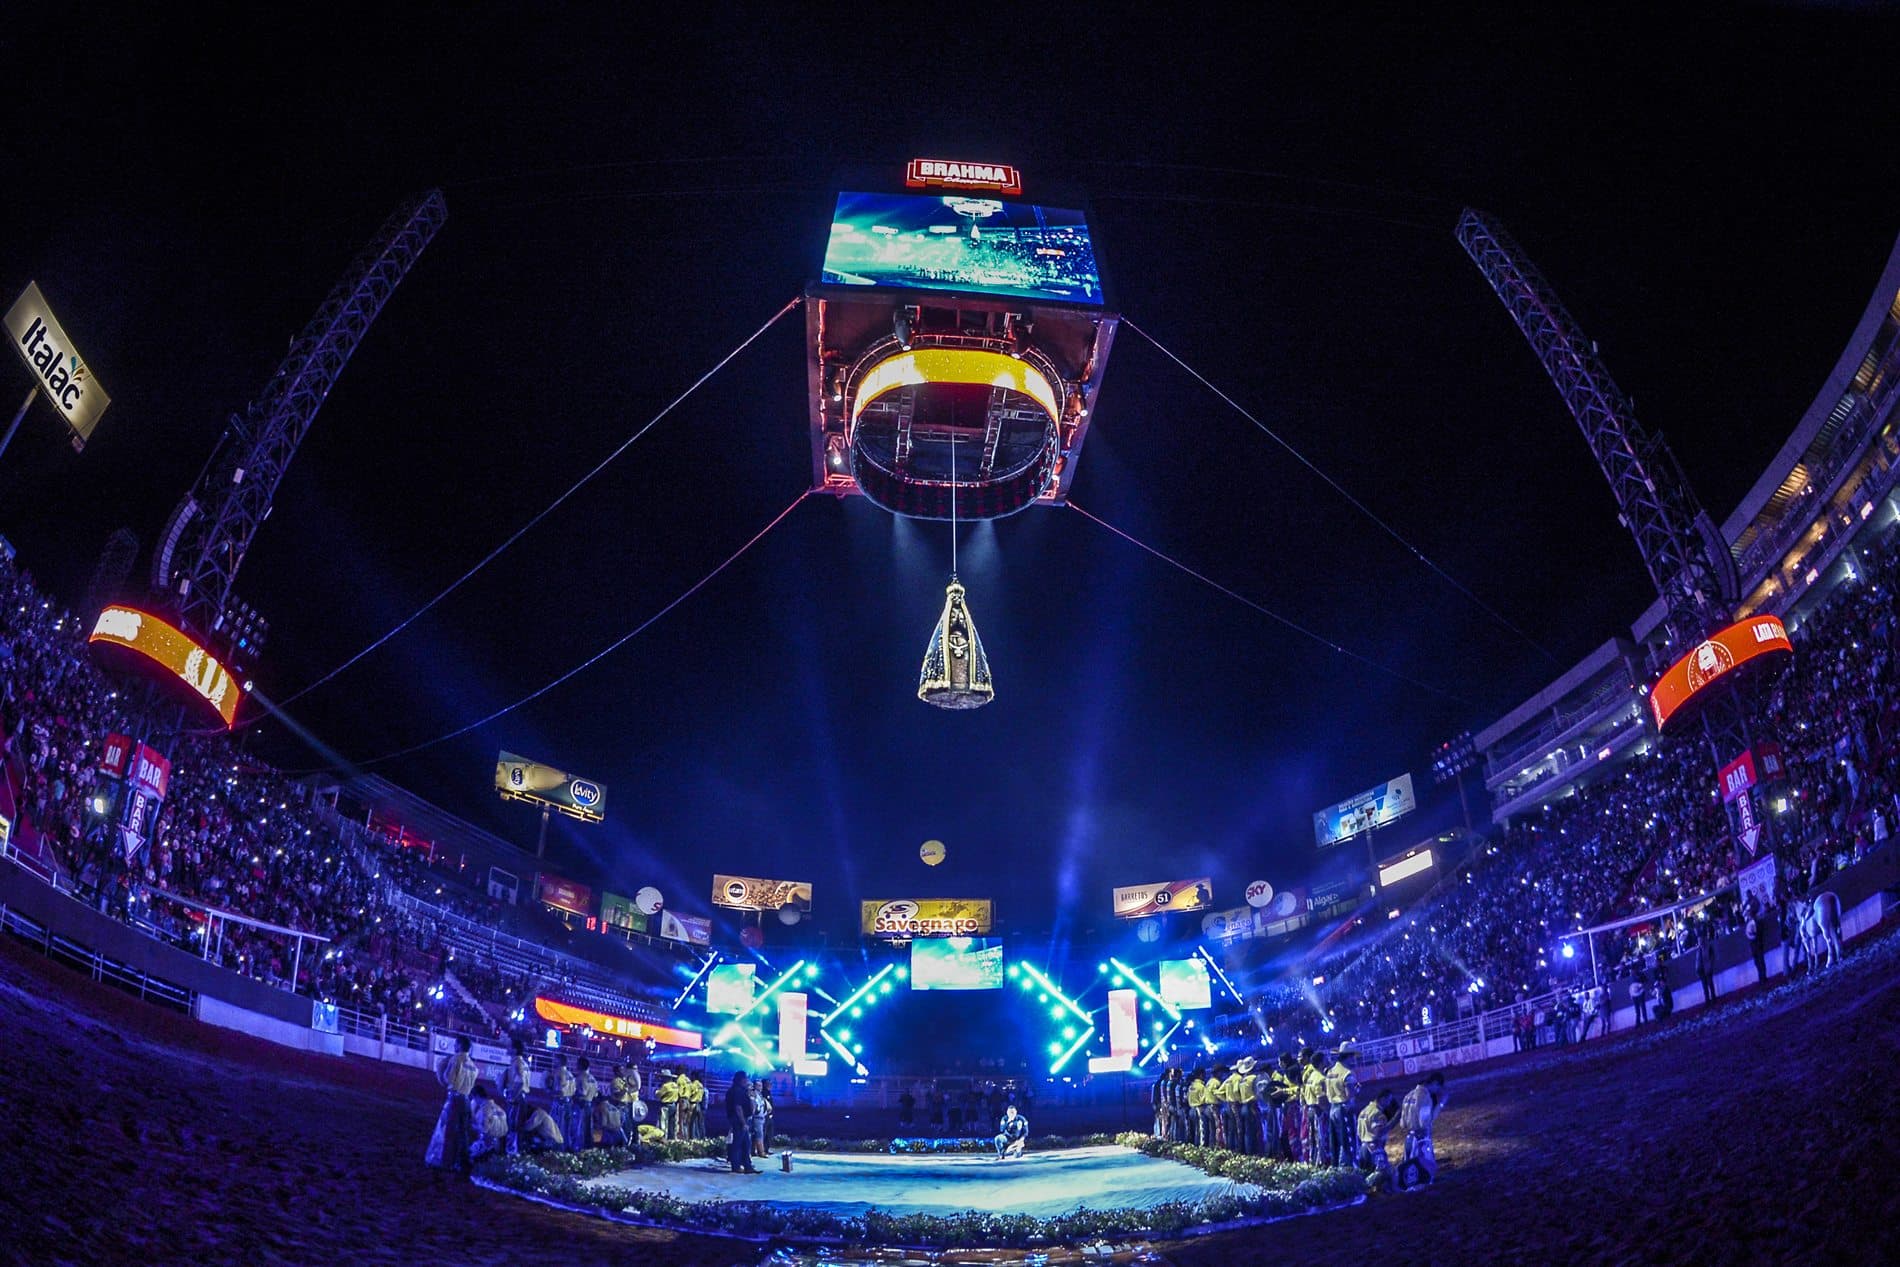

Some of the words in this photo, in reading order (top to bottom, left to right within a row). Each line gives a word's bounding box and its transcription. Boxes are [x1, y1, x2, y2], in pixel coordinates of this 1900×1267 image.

[920, 162, 1007, 181] BRAHMA
[22, 317, 80, 410] Italac
[105, 745, 121, 767] BAR
[139, 759, 161, 788] BAR
[1726, 765, 1748, 792] BAR
[131, 795, 145, 832] BAR
[1738, 796, 1751, 829] BAR
[1157, 893, 1169, 903] 51
[1247, 884, 1266, 899] SKY
[875, 917, 978, 935] Savegnago
